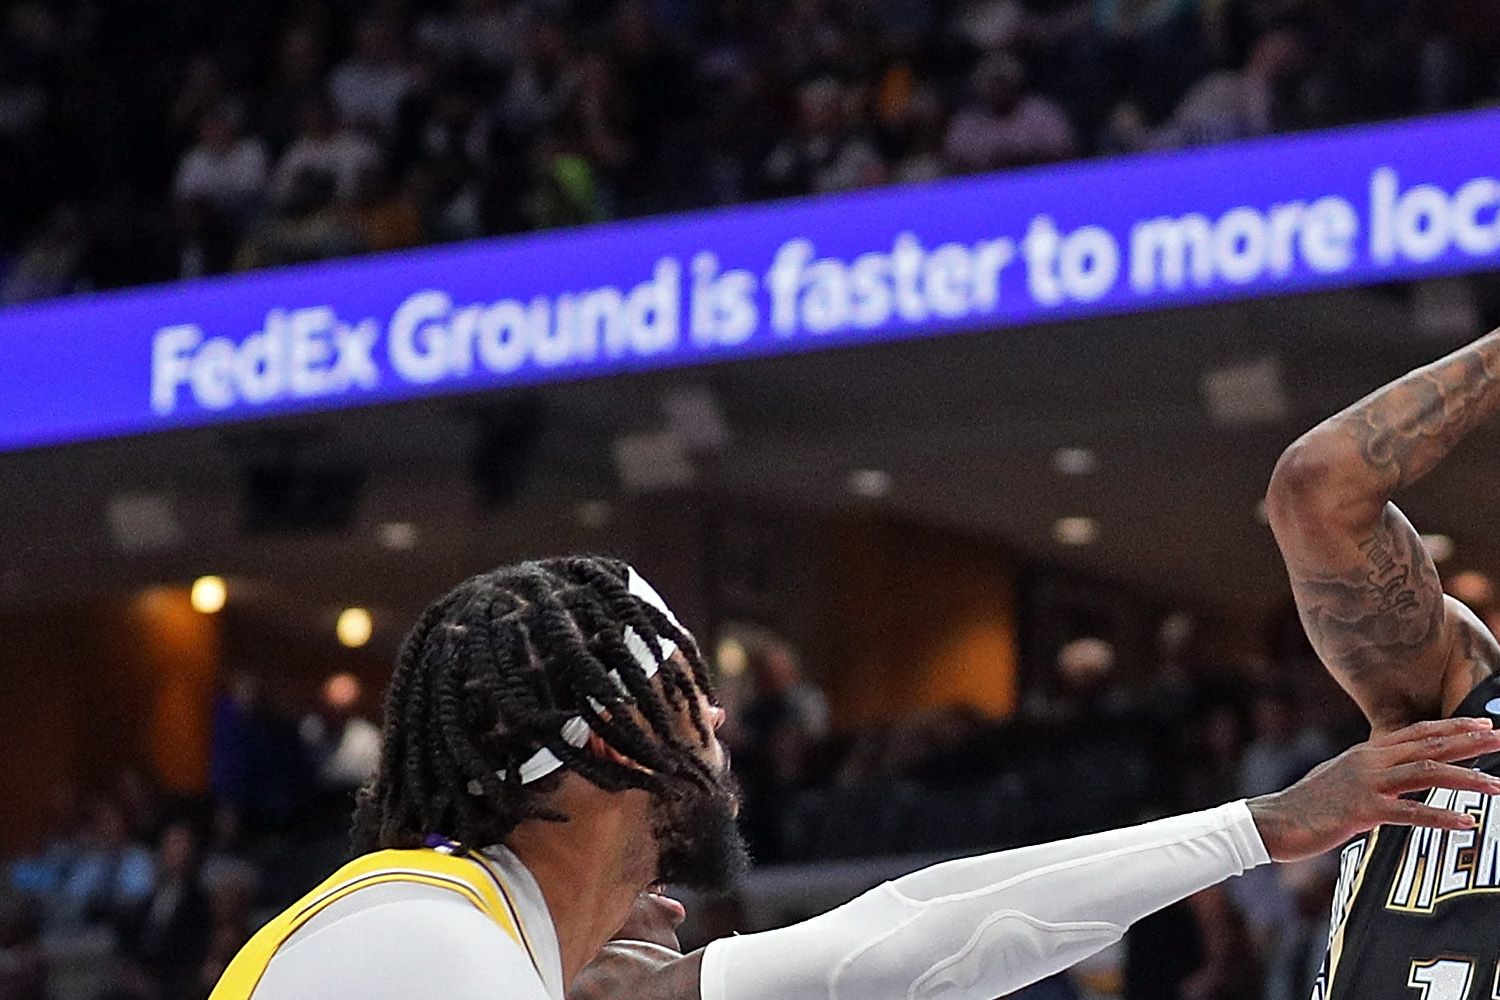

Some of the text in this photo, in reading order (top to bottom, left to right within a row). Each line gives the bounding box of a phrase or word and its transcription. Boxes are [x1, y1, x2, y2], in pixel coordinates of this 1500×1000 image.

[151, 306, 378, 414] FedEx
[388, 256, 680, 384] Ground
[690, 251, 758, 344] is
[766, 234, 1014, 336] faster
[1021, 215, 1120, 305] to
[1129, 196, 1358, 293] more
